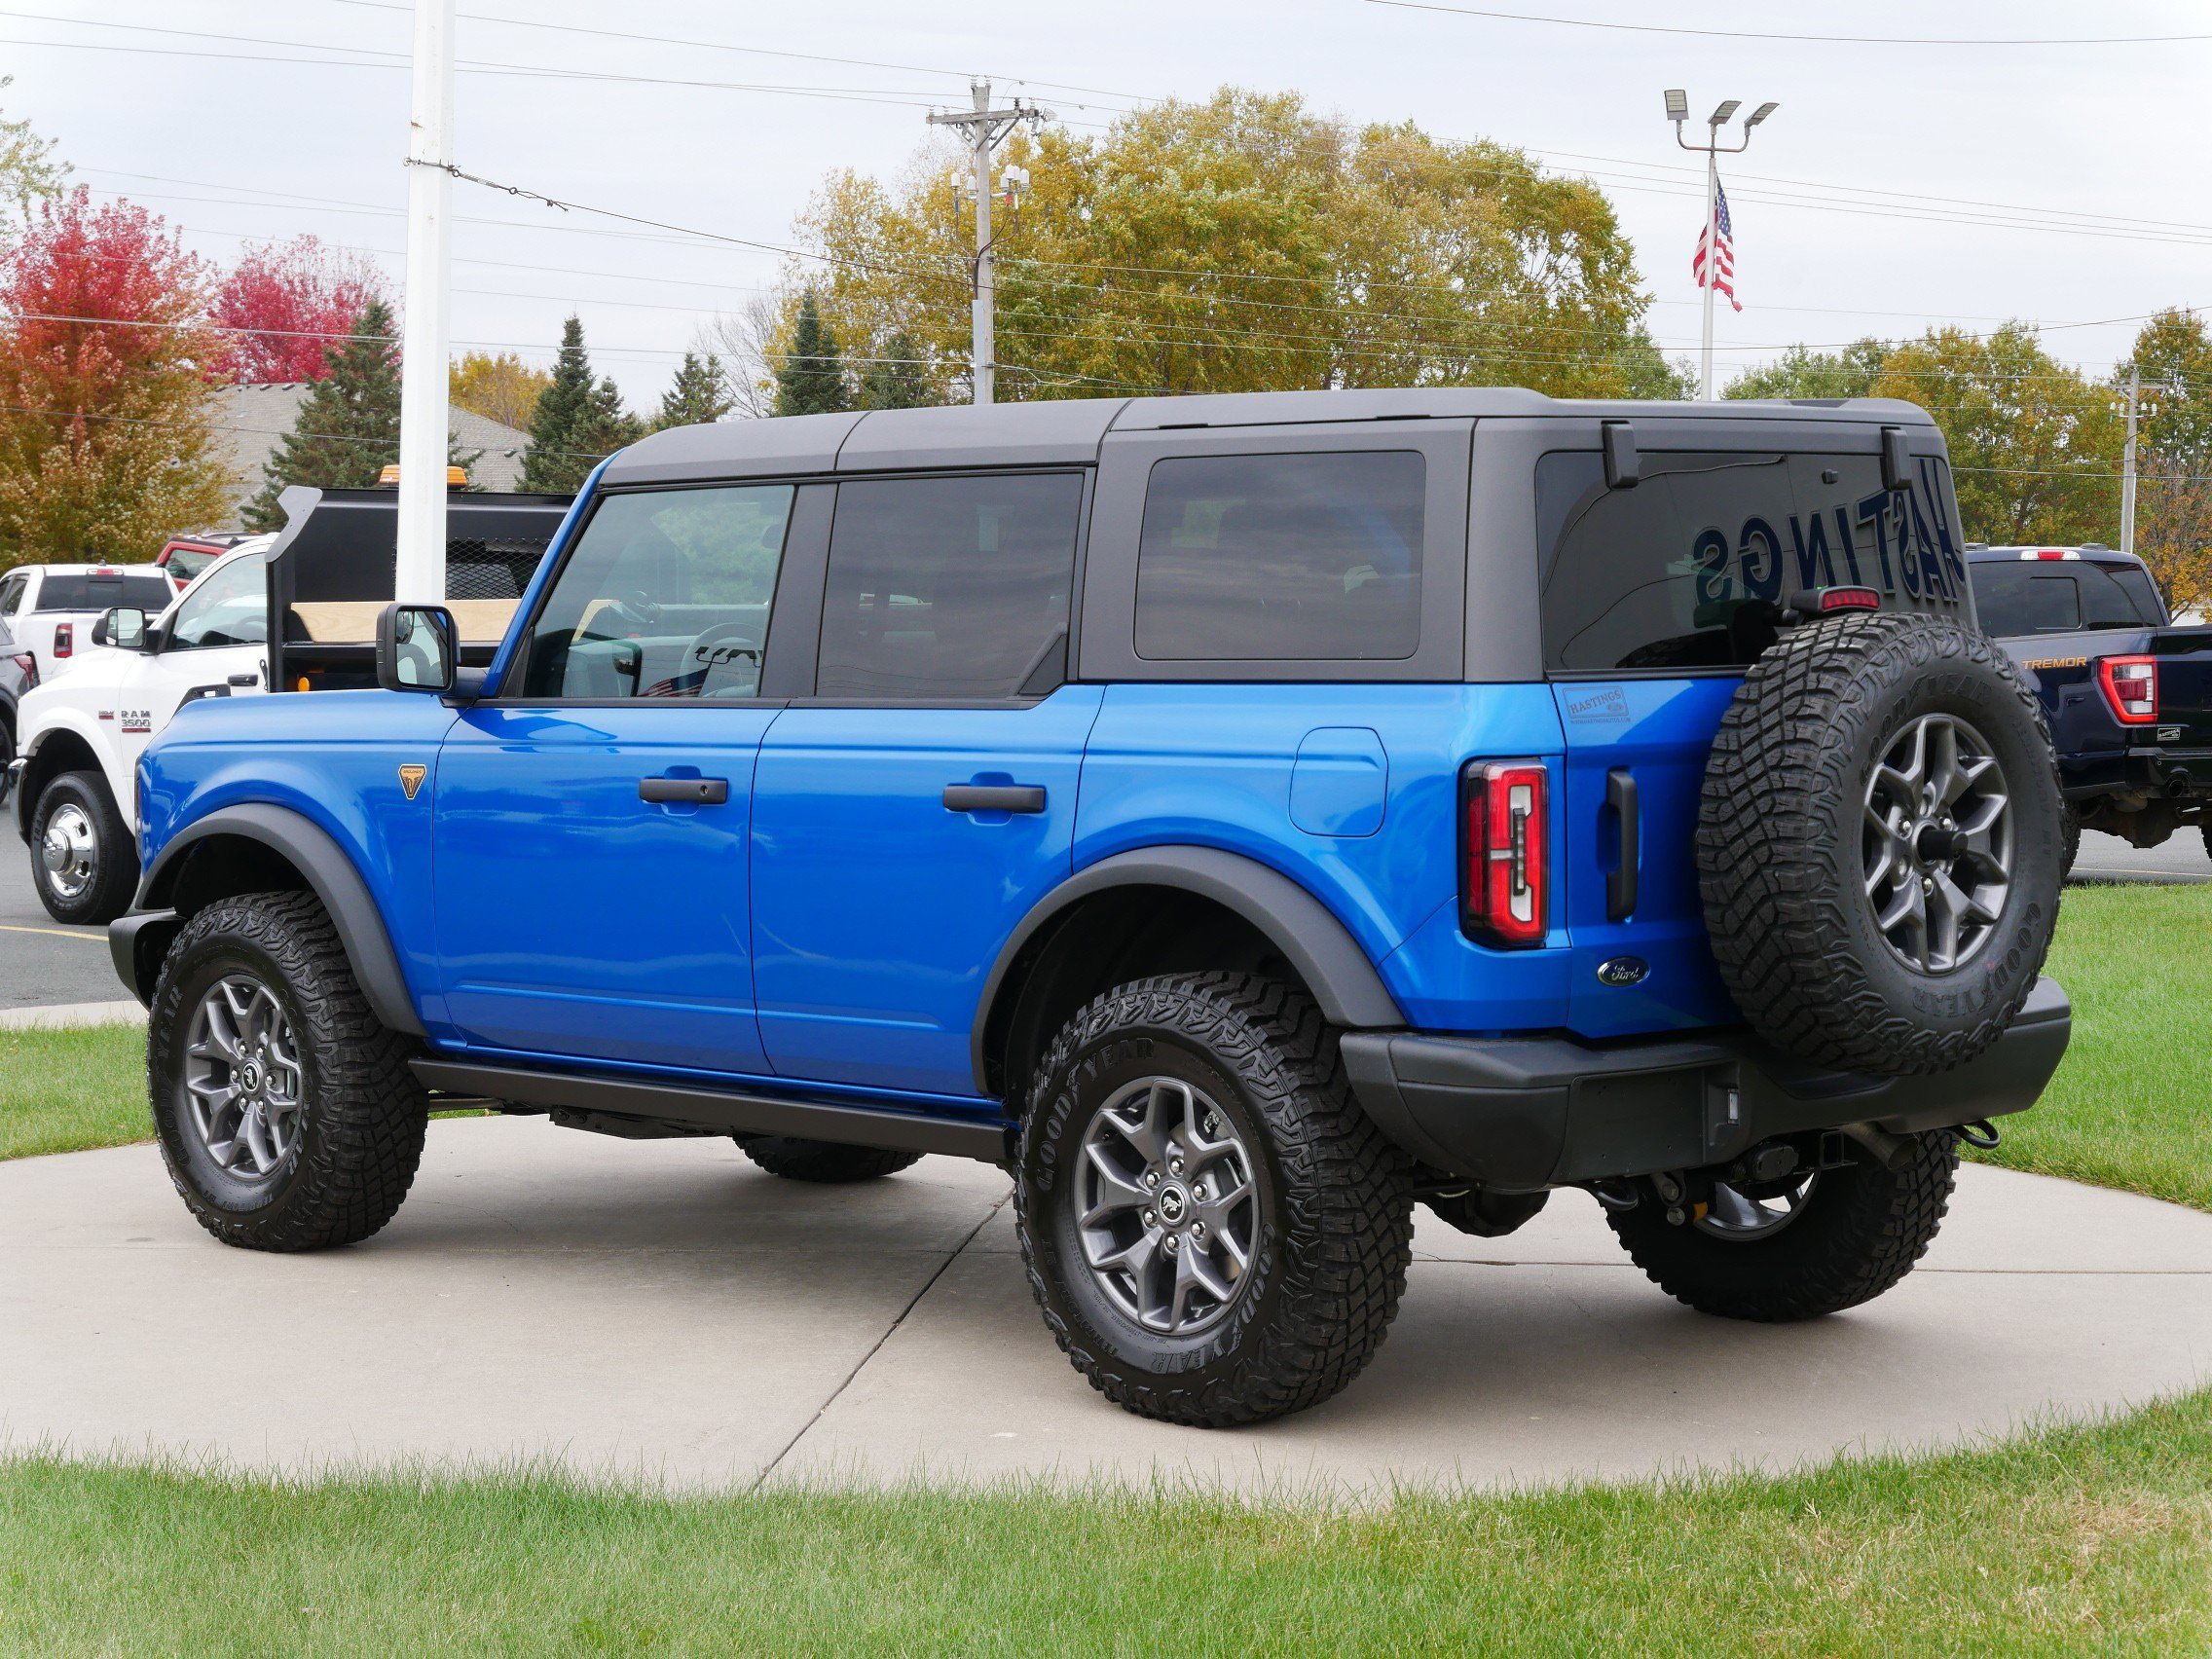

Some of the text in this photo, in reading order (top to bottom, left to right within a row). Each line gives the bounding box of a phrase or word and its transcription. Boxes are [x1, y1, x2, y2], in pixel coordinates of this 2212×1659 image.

[2022, 656, 2087, 670] TREMOR
[121, 710, 151, 719] RAM
[121, 719, 151, 727] 3500
[1570, 689, 1622, 715] HASTINGS
[1860, 673, 1992, 786] GOODYEAR
[1911, 902, 2043, 1018] GOODYEAR
[1035, 1036, 1156, 1192] GOODYEAR
[1152, 1223, 1276, 1375] GOODYEAR
